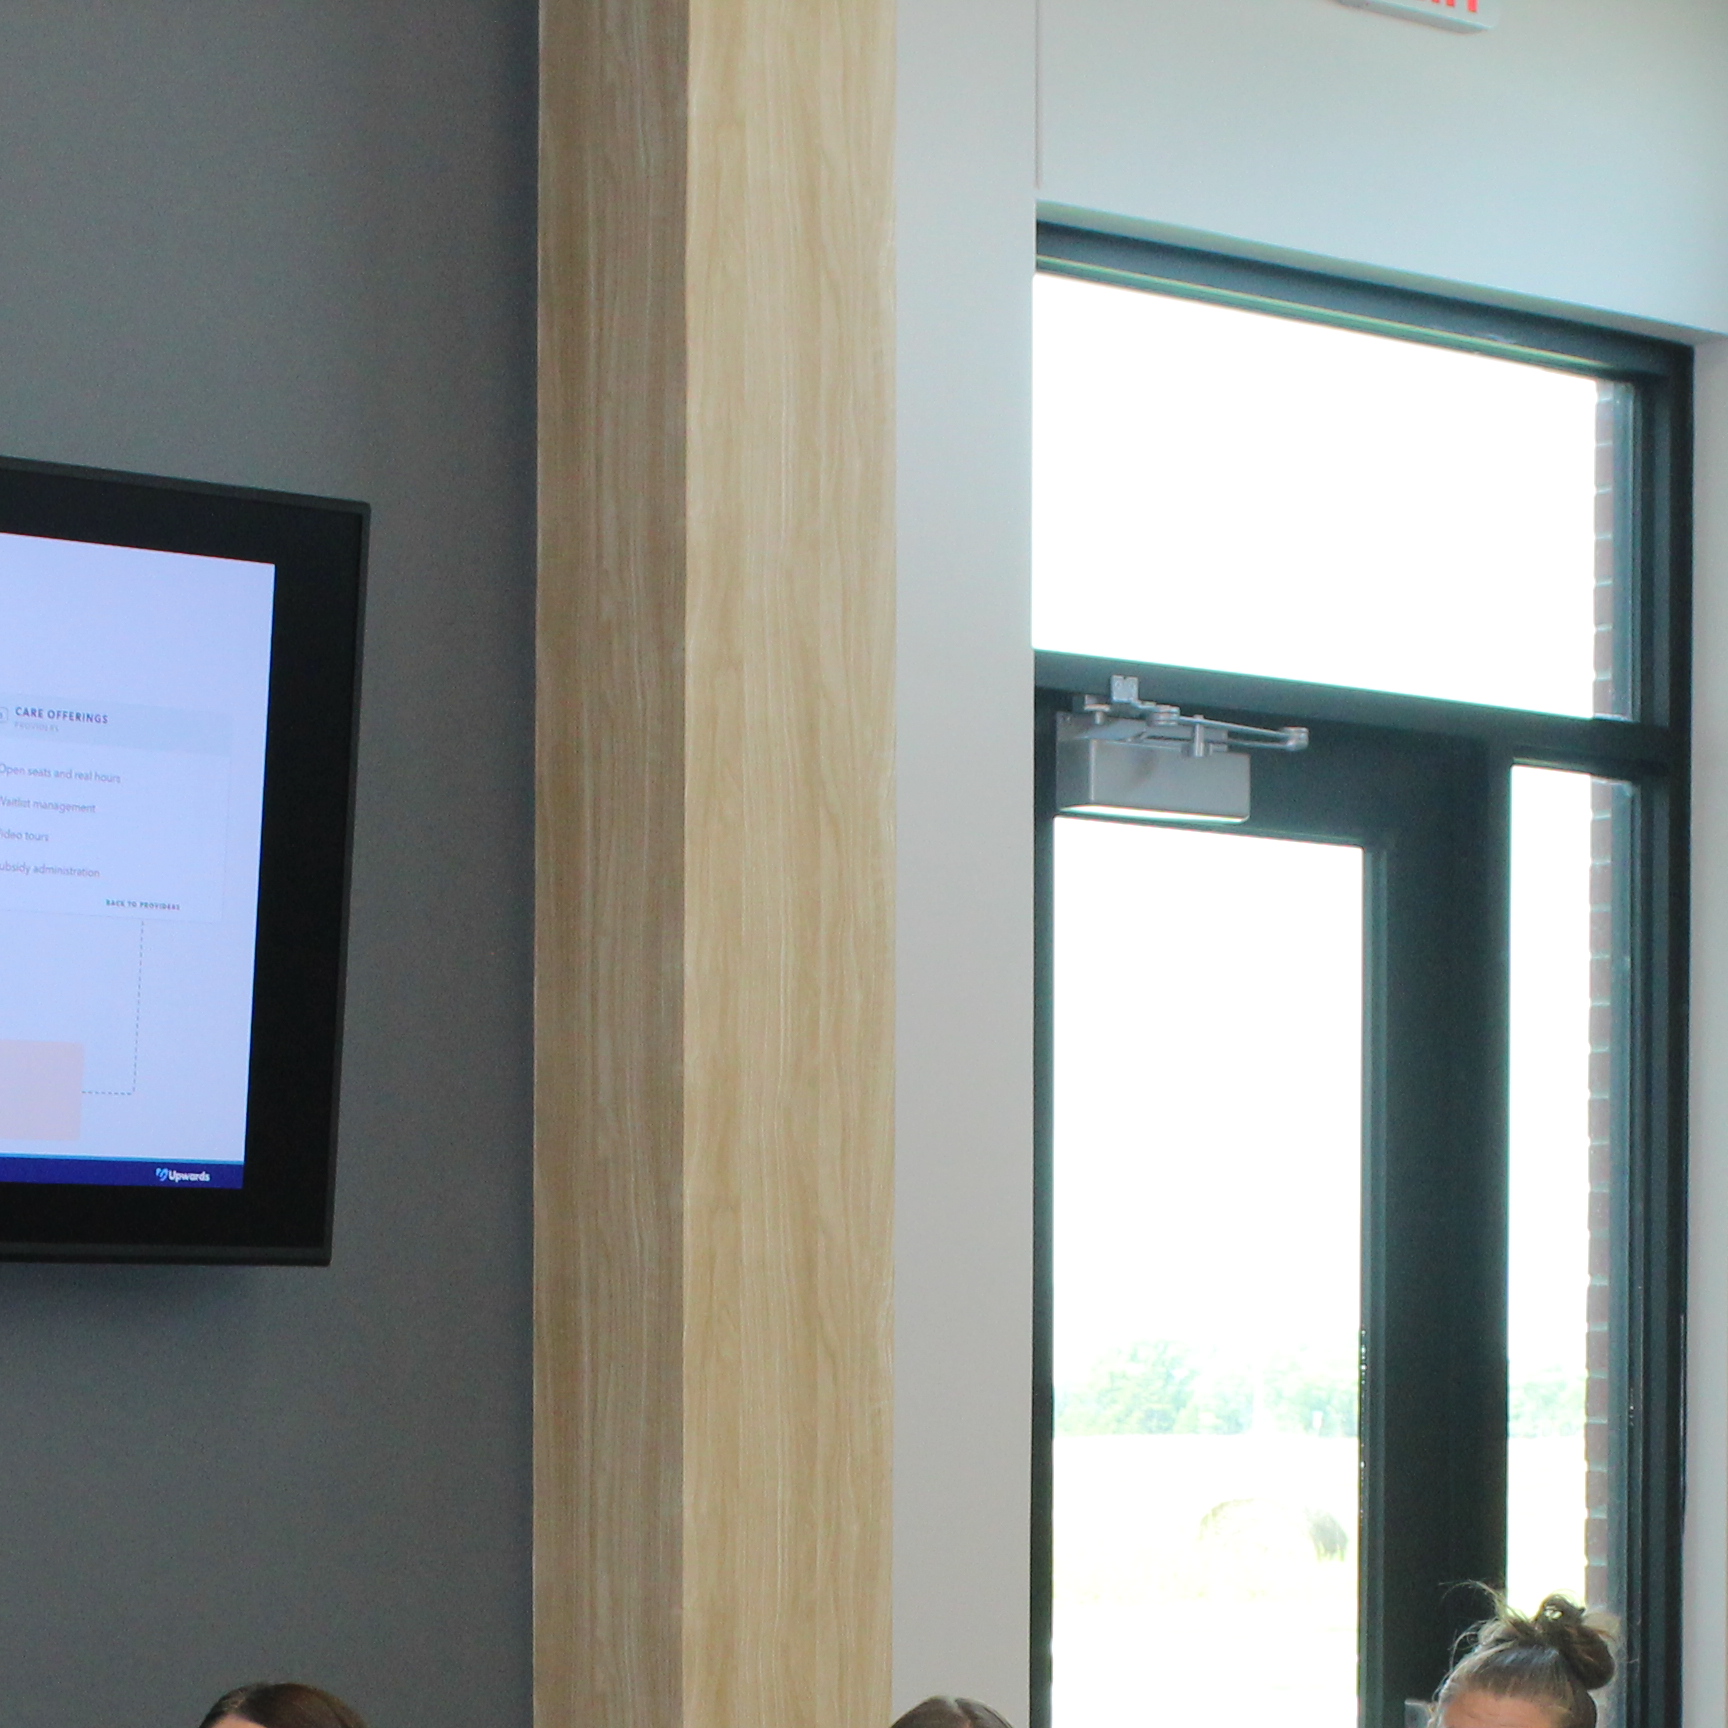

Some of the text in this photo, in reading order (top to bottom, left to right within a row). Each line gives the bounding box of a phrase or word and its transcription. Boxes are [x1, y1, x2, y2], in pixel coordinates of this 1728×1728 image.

[15, 706, 109, 725] CARE OFFERINGS
[27, 768, 52, 778] seats
[54, 769, 72, 780] and
[74, 770, 92, 781] real
[94, 772, 121, 784] hours
[33, 799, 96, 814] management
[25, 830, 49, 842] tours
[32, 864, 100, 878] administration
[168, 1170, 210, 1183] Upwards
